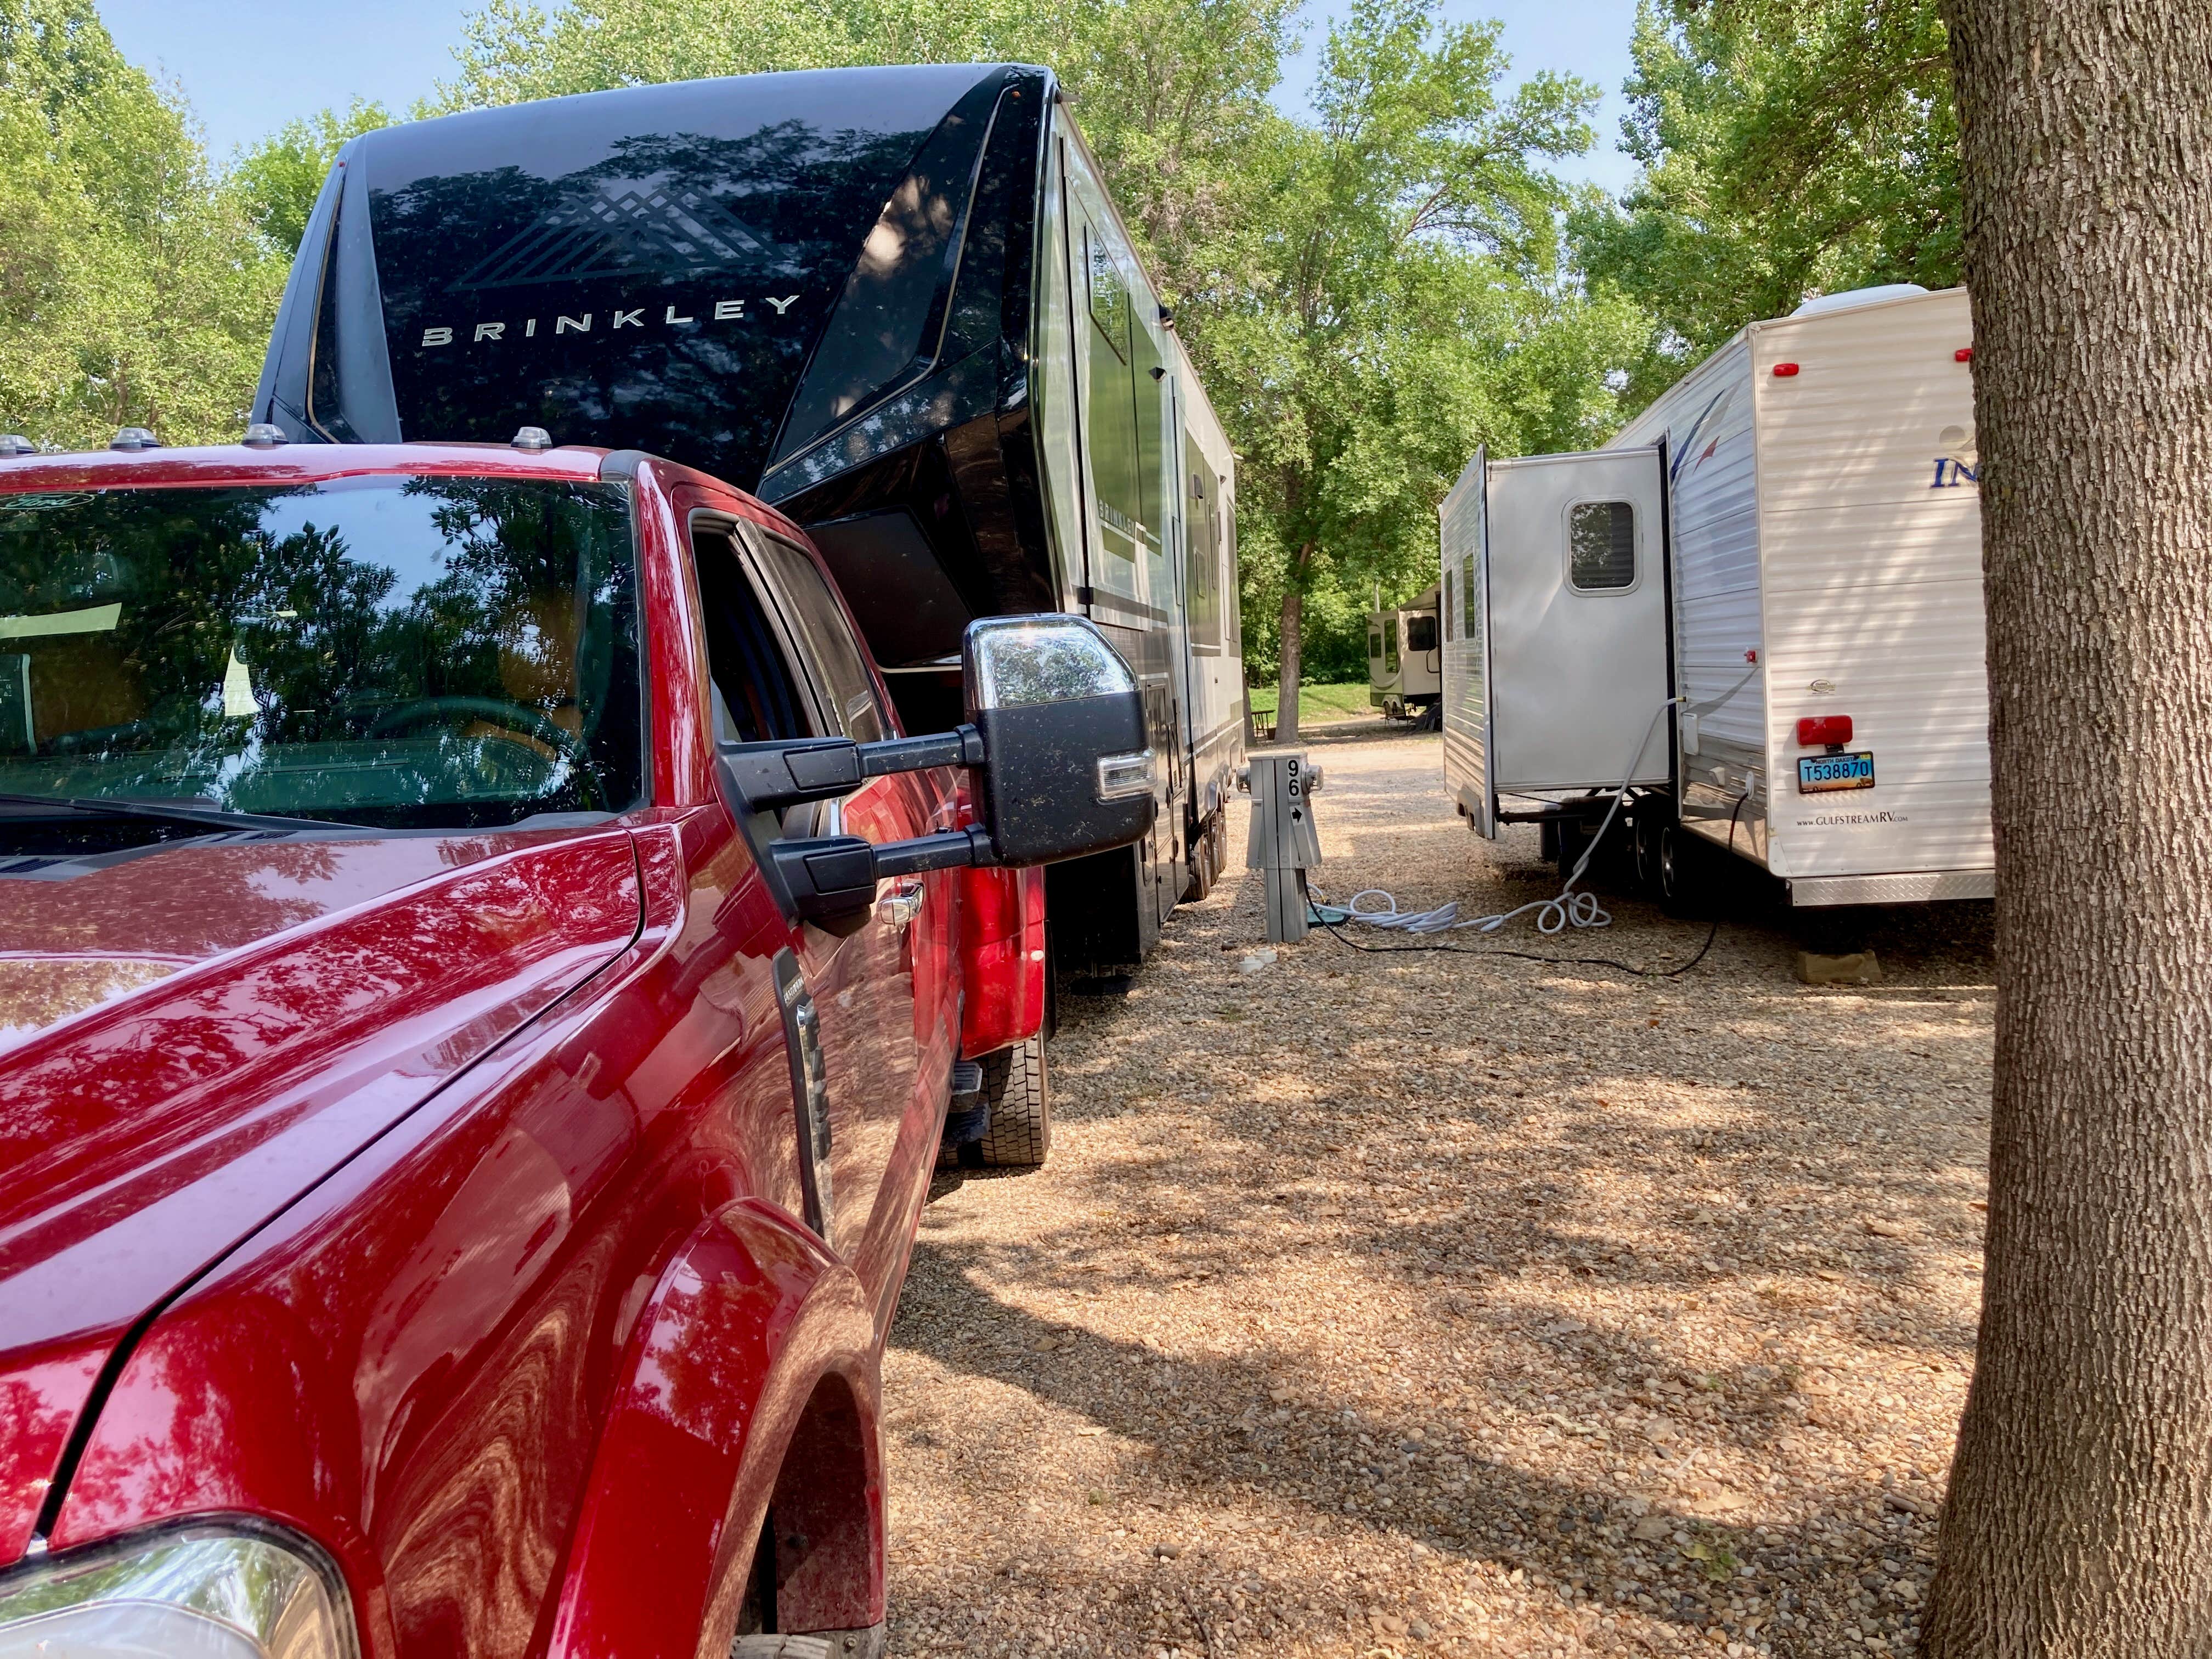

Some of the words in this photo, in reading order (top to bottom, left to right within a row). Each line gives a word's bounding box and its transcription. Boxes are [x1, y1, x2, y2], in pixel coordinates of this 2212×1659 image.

[422, 295, 800, 347] BRINKLEY
[5, 494, 78, 507] Ford
[1804, 761, 1869, 781] T538870
